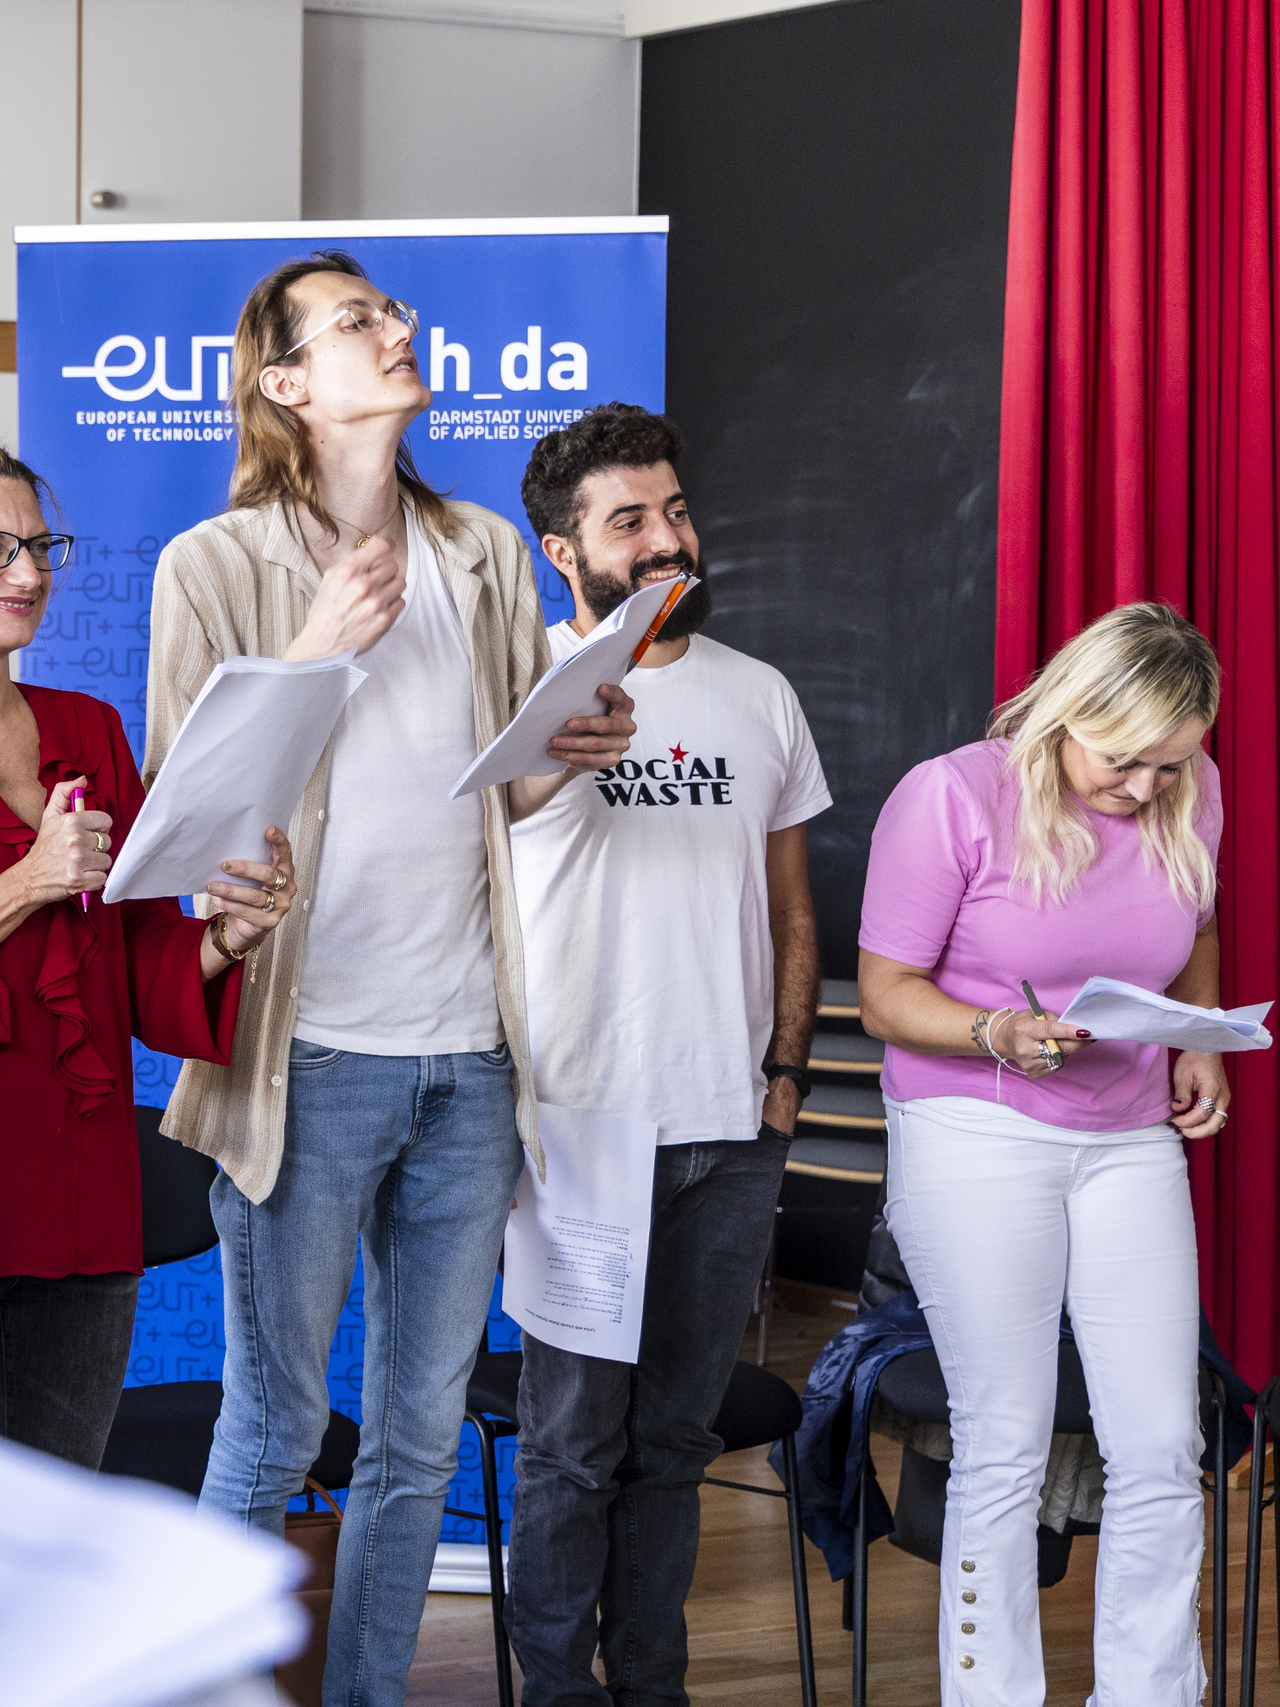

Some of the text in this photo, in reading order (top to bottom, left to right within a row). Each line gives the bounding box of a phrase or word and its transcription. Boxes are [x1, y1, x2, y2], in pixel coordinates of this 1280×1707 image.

[430, 325, 588, 400] h_da
[76, 410, 233, 425] EUROPEAN UNIVERS
[430, 409, 584, 425] DARMSTADT UNIVER
[106, 428, 233, 442] OF TECHNOLOGY
[429, 425, 450, 440] OF
[453, 425, 519, 440] APPLIED
[596, 781, 733, 807] WASTE
